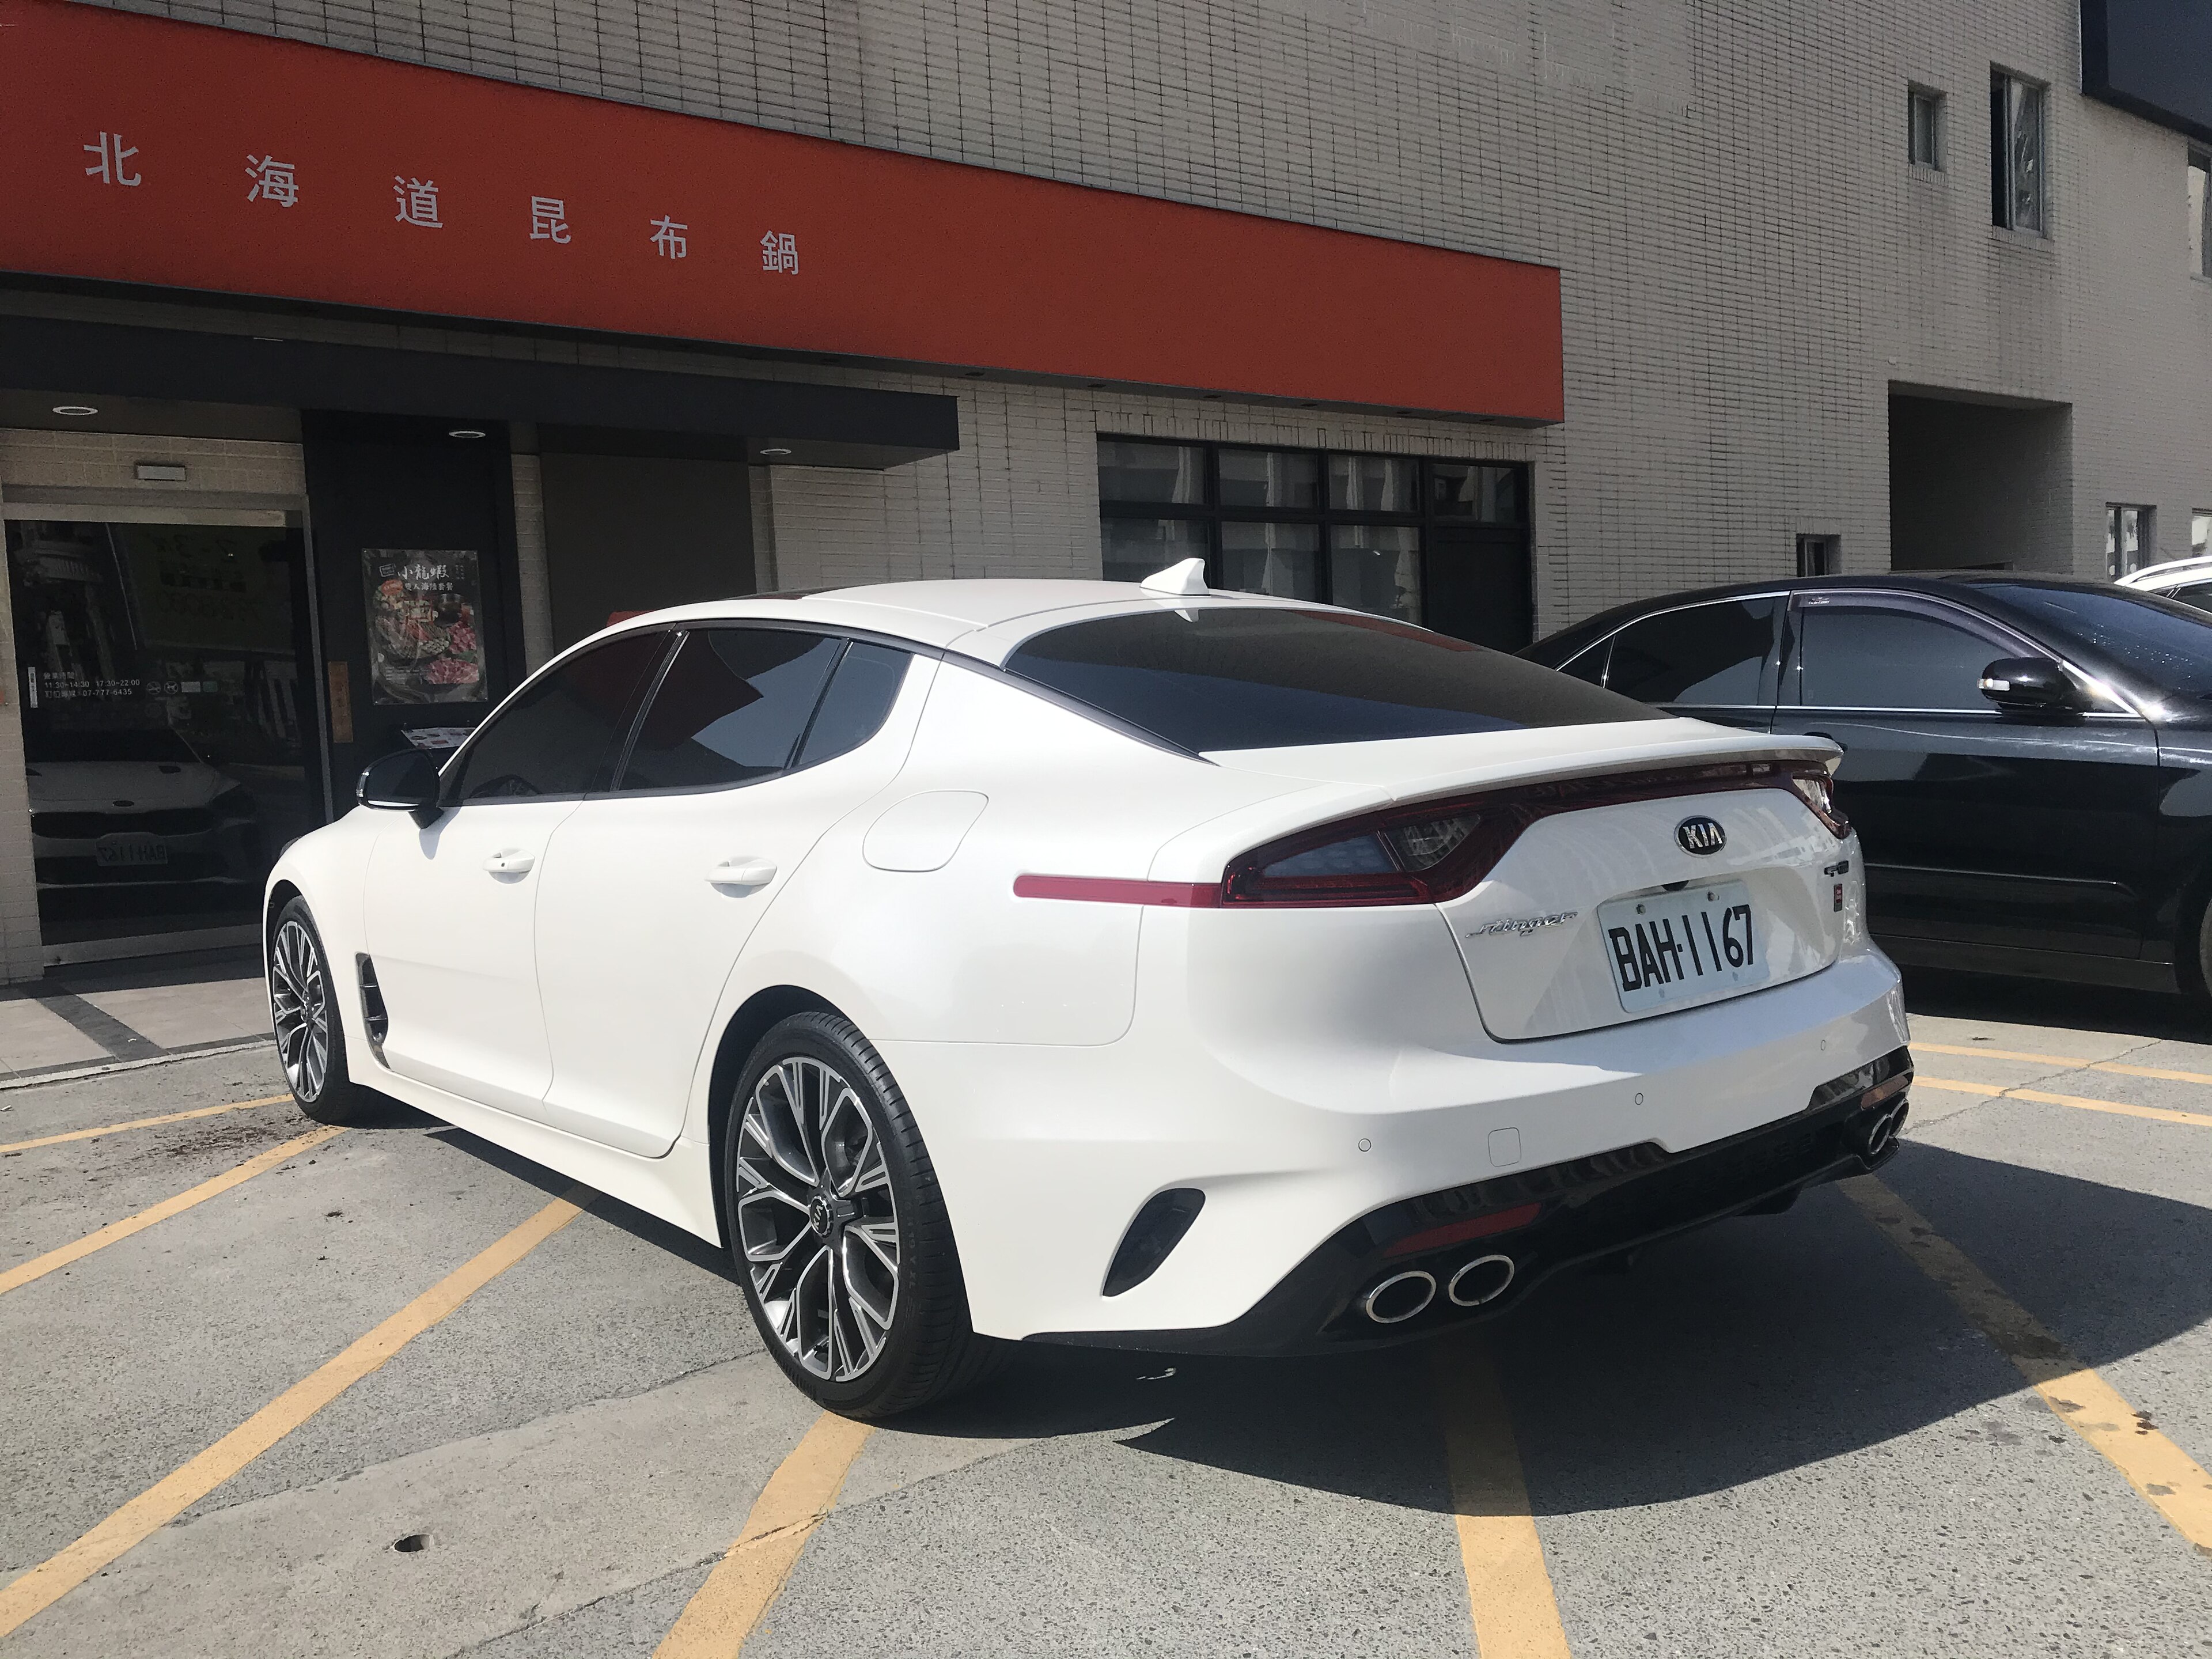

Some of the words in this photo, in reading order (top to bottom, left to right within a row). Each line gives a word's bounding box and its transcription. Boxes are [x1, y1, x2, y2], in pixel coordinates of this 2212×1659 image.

[83, 131, 800, 275] 北海道昆布鍋
[397, 563, 449, 580] 小龍蝦
[1682, 822, 1723, 849] KIA
[813, 1205, 823, 1230] KIA
